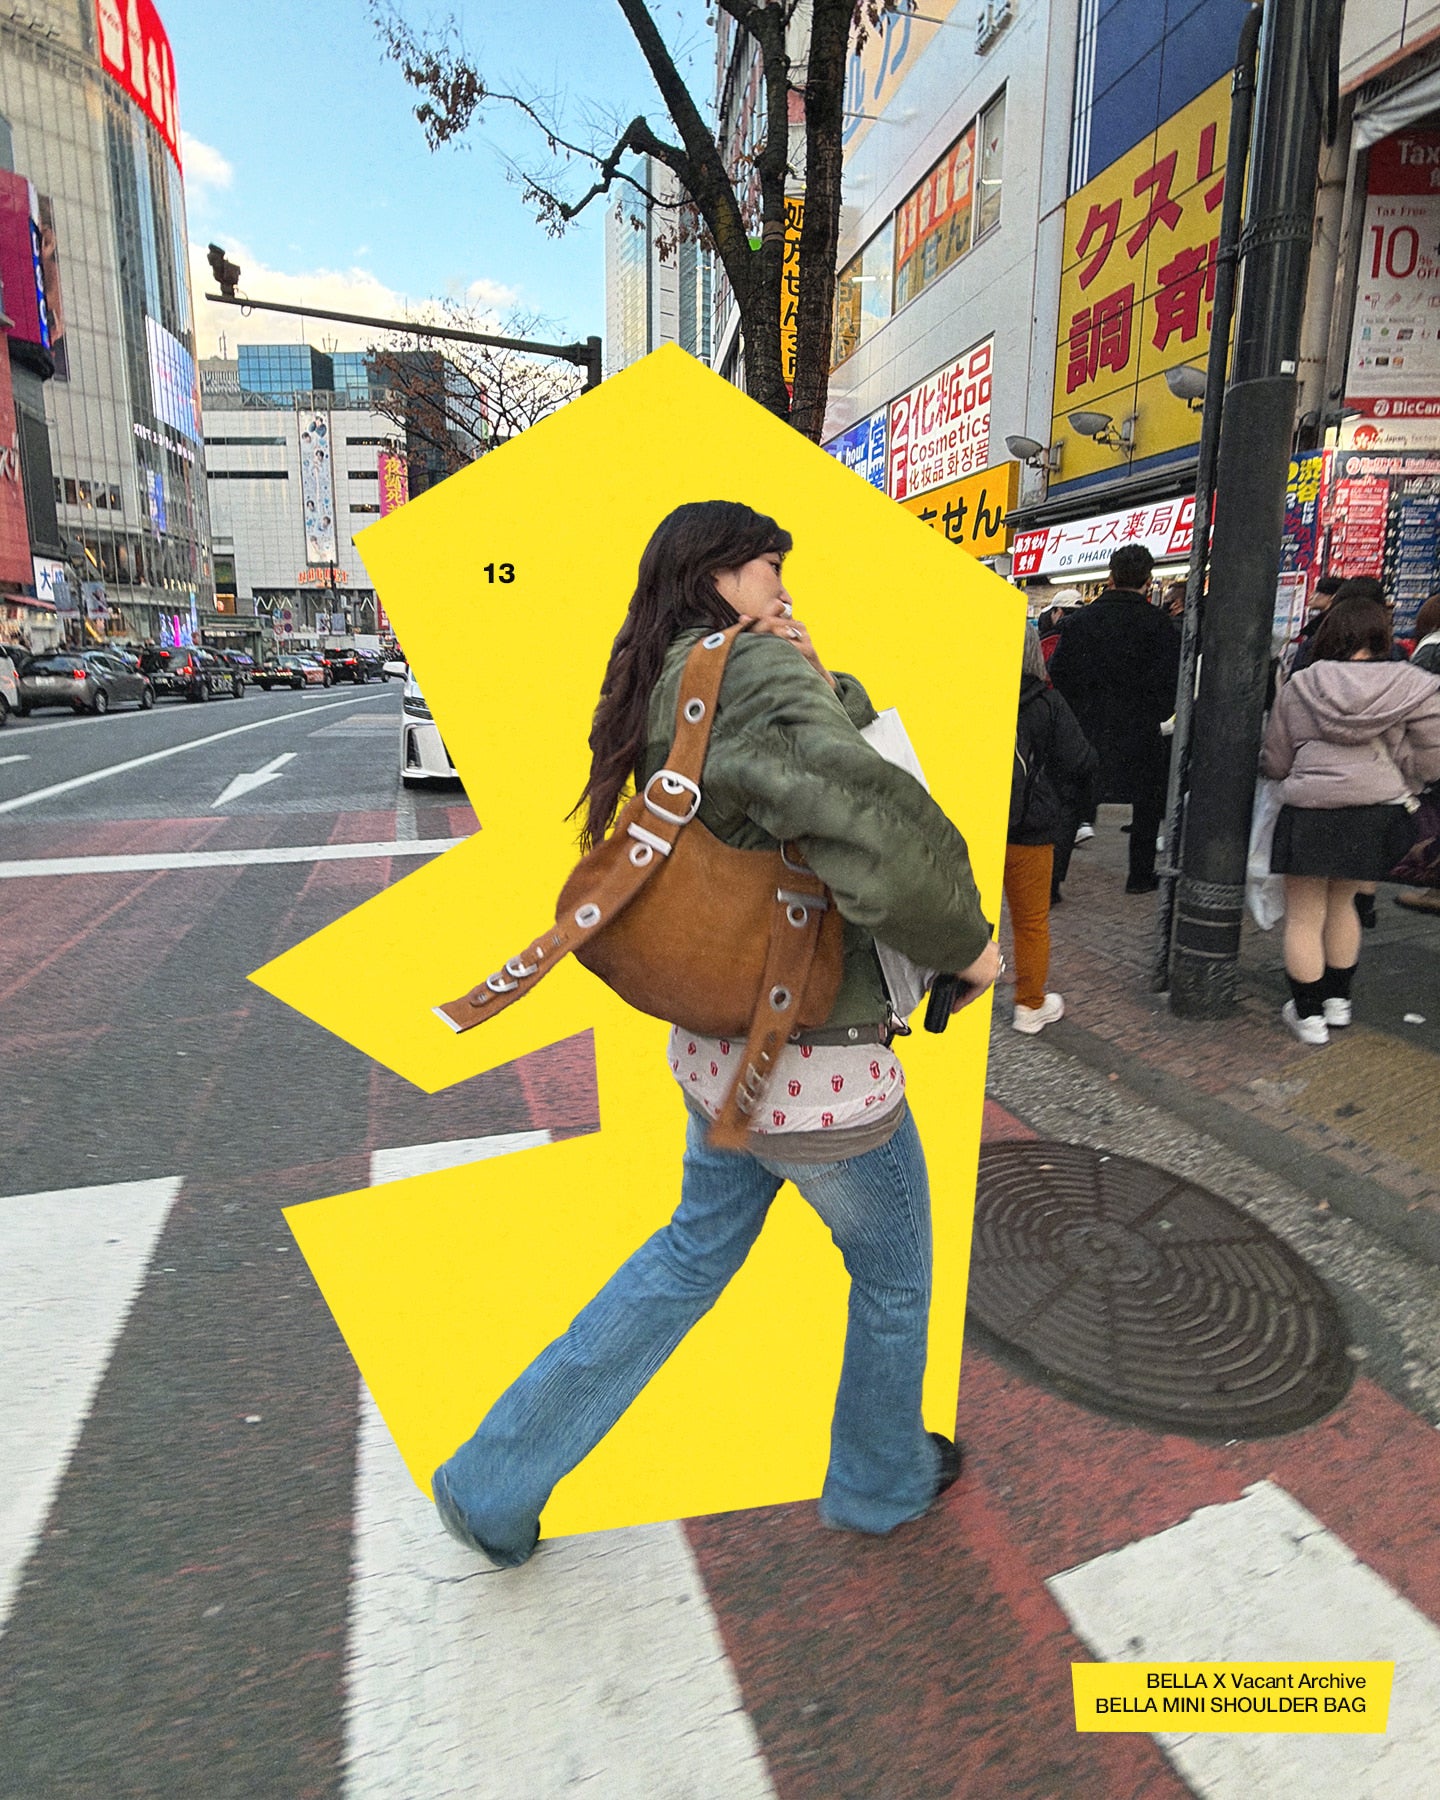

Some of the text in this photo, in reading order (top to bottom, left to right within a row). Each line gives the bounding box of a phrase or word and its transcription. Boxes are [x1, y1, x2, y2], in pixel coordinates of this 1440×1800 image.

[911, 344, 992, 441] 化粧品
[909, 412, 990, 467] Cosmetics
[1048, 504, 1174, 554] オーエス薬局
[1059, 554, 1073, 567] OS
